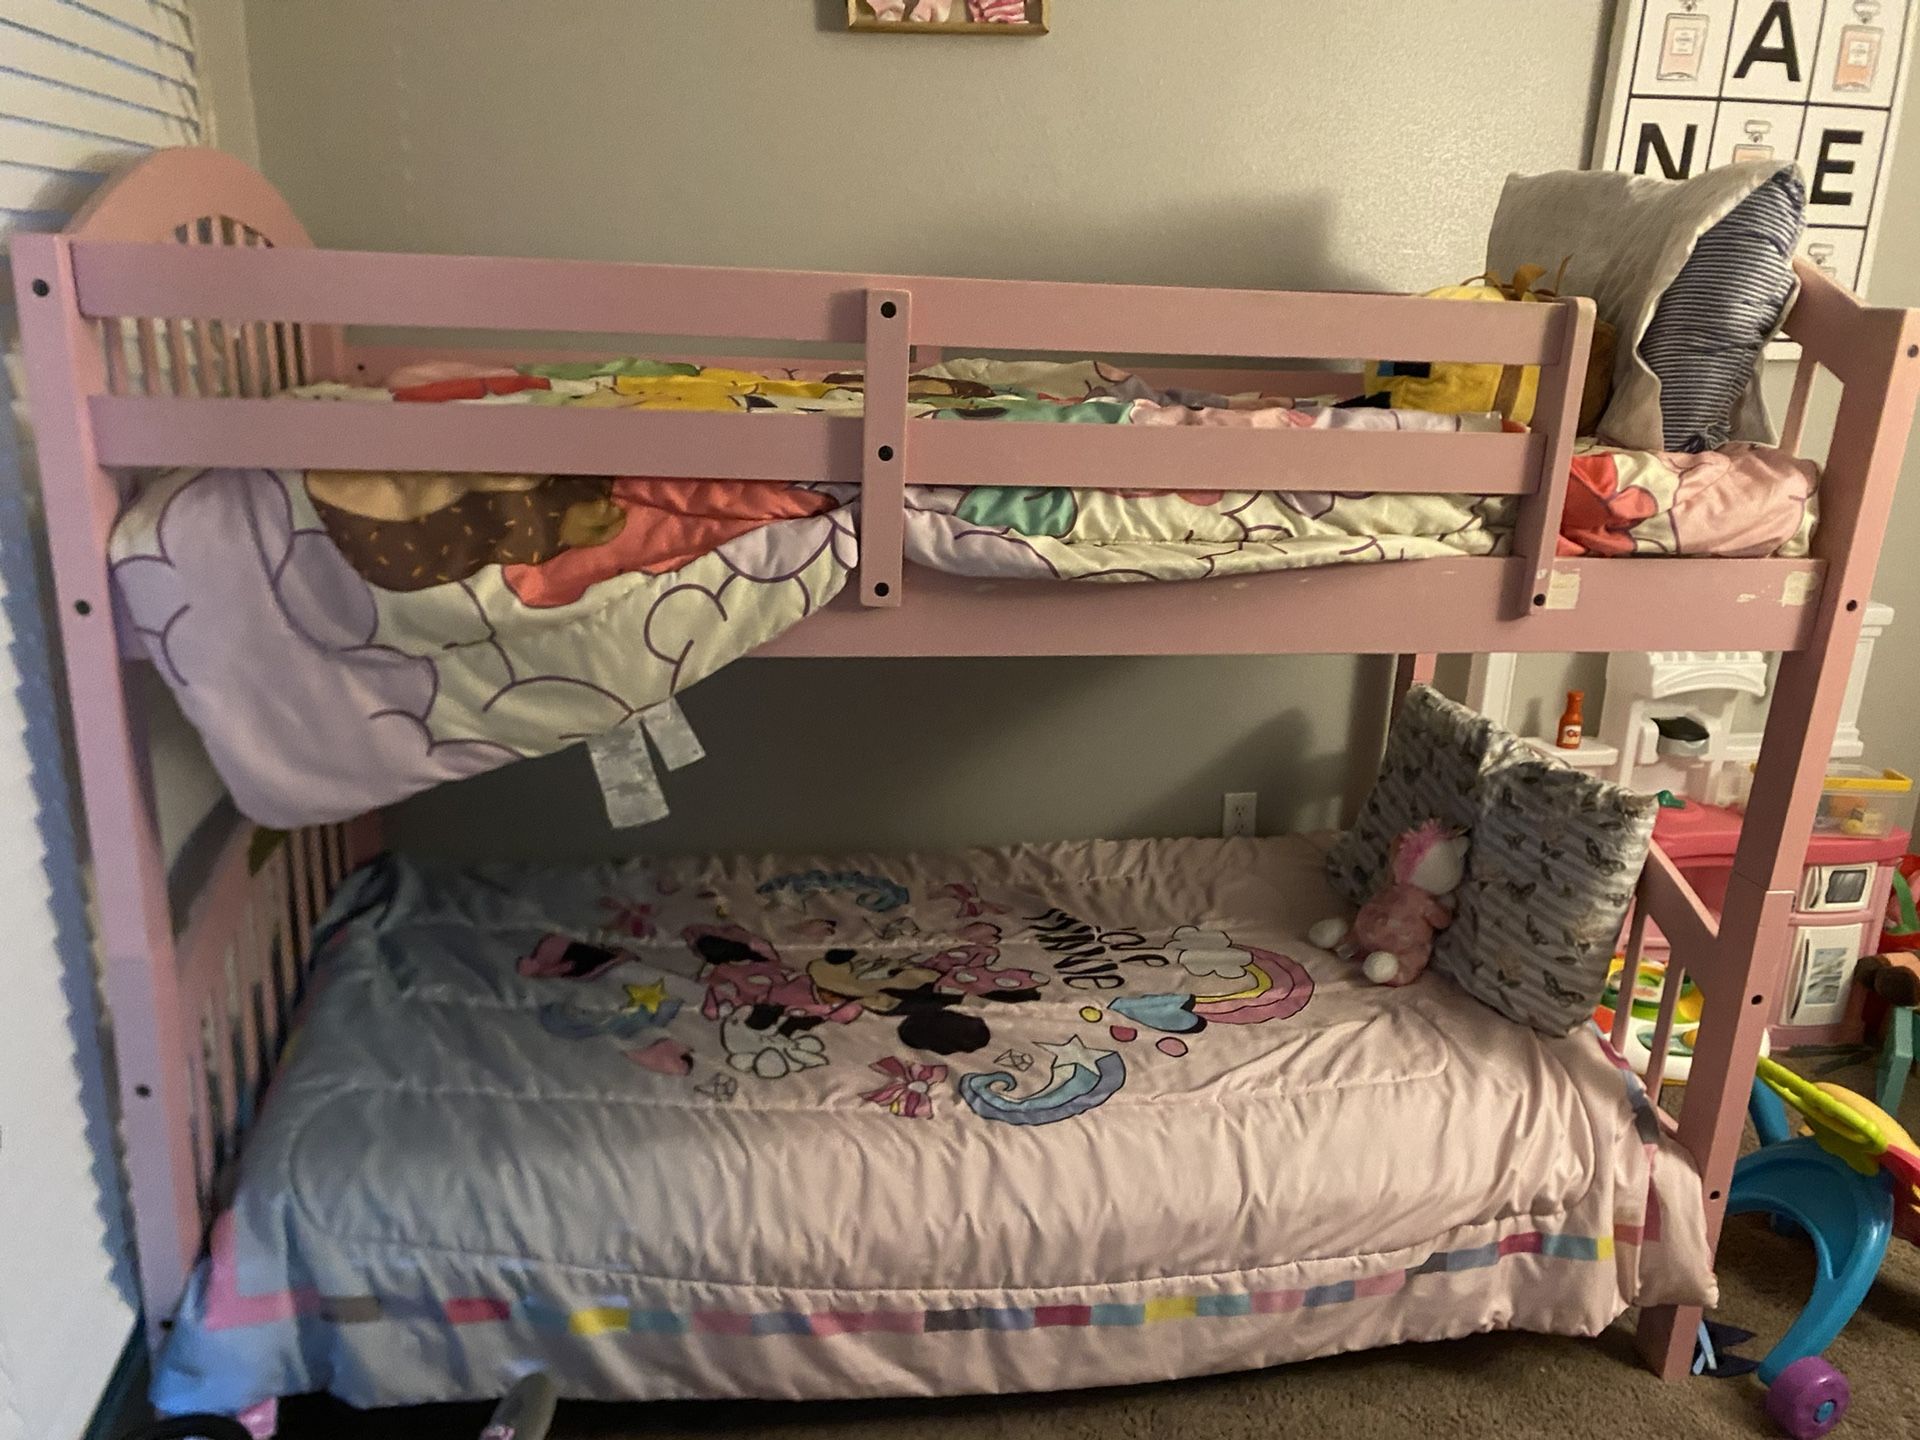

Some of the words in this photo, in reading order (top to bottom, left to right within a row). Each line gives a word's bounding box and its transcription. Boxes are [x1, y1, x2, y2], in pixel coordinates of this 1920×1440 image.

[1732, 0, 1801, 82] A
[1634, 123, 1699, 180] N
[1809, 129, 1864, 206] E
